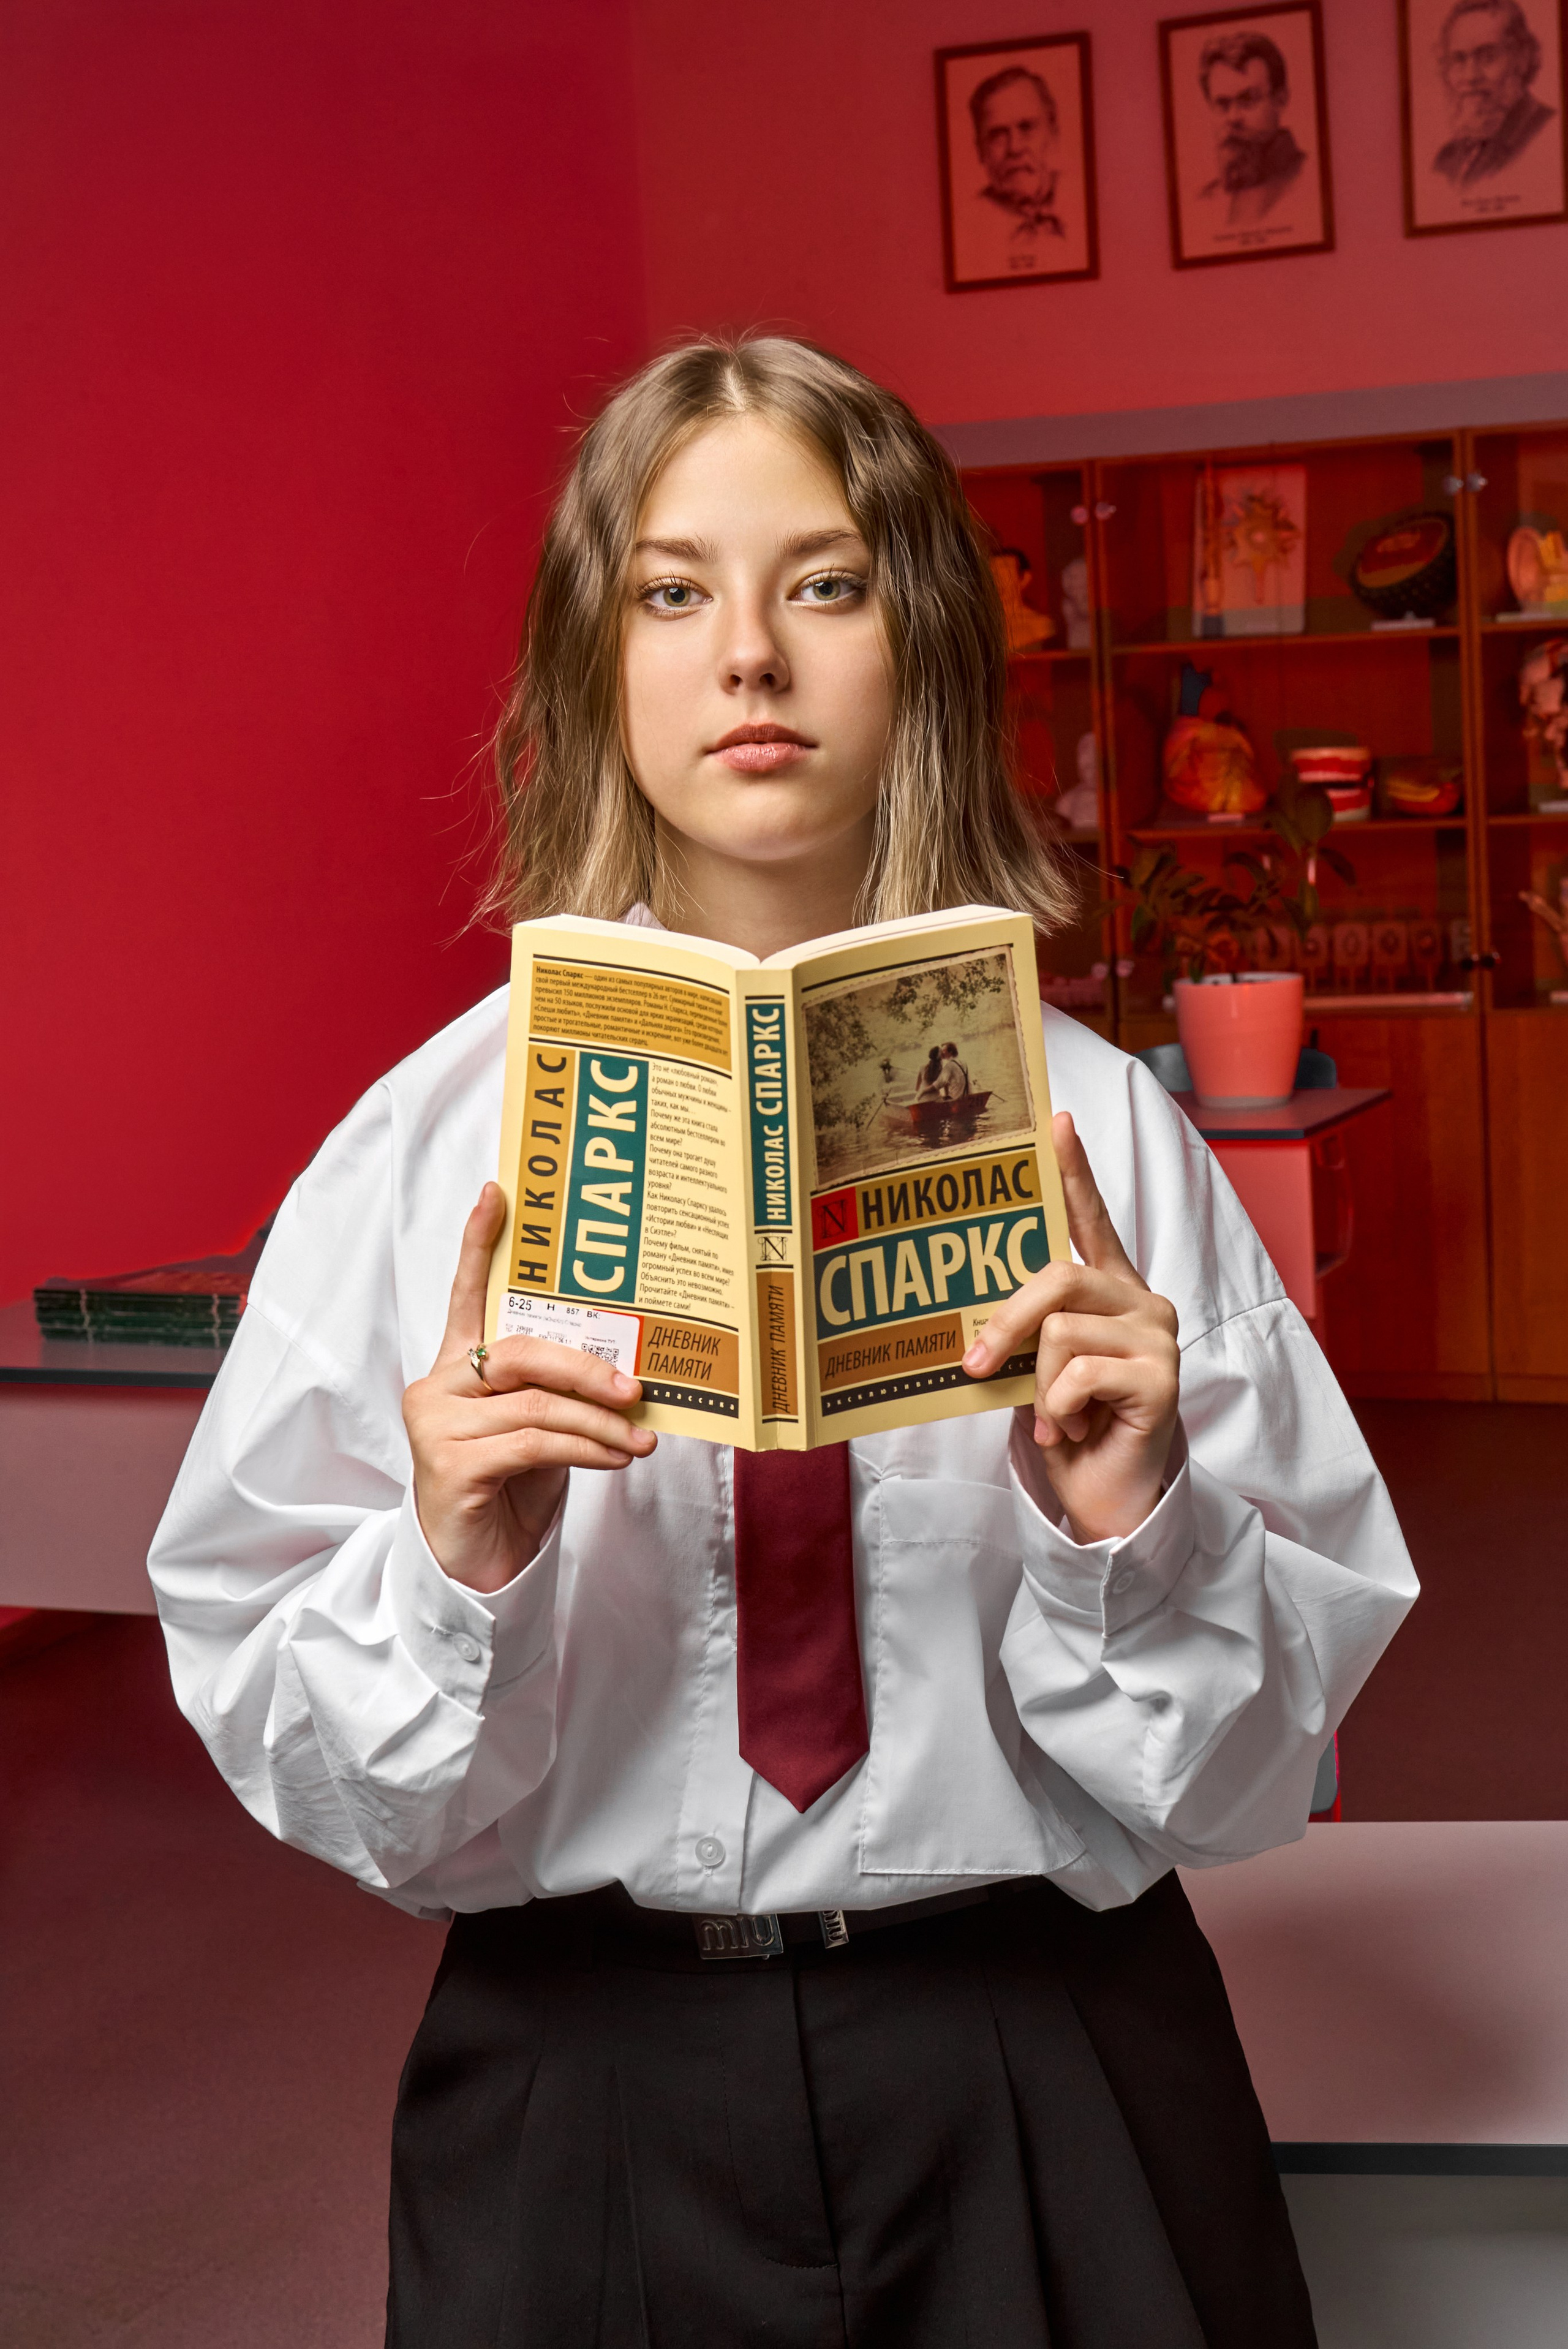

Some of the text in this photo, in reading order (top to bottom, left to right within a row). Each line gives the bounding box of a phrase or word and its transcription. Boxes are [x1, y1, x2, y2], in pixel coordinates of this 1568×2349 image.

[537, 966, 561, 976] Николас
[562, 970, 583, 979] Спаркс
[633, 981, 663, 990] популярных
[535, 986, 562, 995] превысил
[574, 992, 605, 1001] миллионов
[606, 996, 641, 1006] экземпляров.
[644, 1000, 663, 1010] Романы
[571, 982, 617, 992] международный
[619, 987, 647, 998] бестселлер
[562, 1000, 584, 1008] языков,
[535, 1005, 555, 1013] «Спеши
[556, 1006, 581, 1017] любить»,
[583, 1011, 609, 1020] «Дневник
[639, 1019, 663, 1029] «Дальняя
[563, 1019, 602, 1030] трогательные,
[603, 1024, 641, 1035] романтичные
[533, 1024, 648, 1046] покоряют миллионы читательских сердец.
[652, 1063, 662, 1071] Это
[671, 1068, 699, 1079] «любовный
[652, 1087, 677, 1098] обычных
[680, 1082, 696, 1090] любви.
[651, 1099, 668, 1109] таких,
[752, 1008, 786, 1220] НИКОЛАС СПАРКС
[650, 1121, 685, 1134] абсолютным
[651, 1109, 672, 1122] Почему
[692, 1119, 705, 1128] книга
[706, 1123, 718, 1133] стала
[666, 1136, 682, 1146] мире?
[649, 1157, 718, 1178] читателей самого разного
[650, 1144, 671, 1157] Почему
[684, 1152, 703, 1162] трогает
[704, 1157, 716, 1168] душу
[518, 1054, 567, 1283] НИКОЛАС
[573, 1060, 638, 1293] СПАРКС
[649, 1169, 674, 1178] возраста
[648, 1180, 672, 1190] уровня?
[862, 1159, 1033, 1229] НИКОЛАС
[660, 1192, 686, 1205] Николасу
[687, 1198, 707, 1212] Спарксу
[709, 1205, 726, 1216] удалось
[646, 1214, 674, 1225] «Истории
[676, 1220, 696, 1230] любви»
[647, 1204, 729, 1229] повторить сенсационный успех
[650, 1226, 677, 1237] Сиэтле»?
[644, 1237, 668, 1250] Почему
[669, 1241, 690, 1253] фильм,
[692, 1247, 711, 1256] снятый
[643, 1250, 666, 1261] роману
[669, 1253, 697, 1265] «Дневник
[698, 1261, 721, 1273] памяти»,
[820, 1216, 1038, 1326] СПАРКС
[641, 1272, 675, 1284] Объяснить
[688, 1281, 723, 1295] невозможно.
[642, 1262, 674, 1272] огромный
[701, 1272, 714, 1281] всем
[715, 1277, 730, 1286] мире?
[508, 1296, 532, 1311] 6-25
[640, 1283, 729, 1308] Прочитайте «Дневник памяти»
[644, 1297, 672, 1307] поймете
[674, 1301, 691, 1311] сами!
[973, 1318, 989, 1327] Книг
[648, 1327, 721, 1356] ДНЕВНИК
[768, 1285, 790, 1414] ДНЕВНИК ПАМЯТИ
[647, 1352, 712, 1381] ПАМЯТИ
[824, 1330, 956, 1380] ДНЕВНИК ПАМЯТИ
[654, 1390, 734, 1411] классика
[827, 1374, 956, 1408] эксклюзивная
